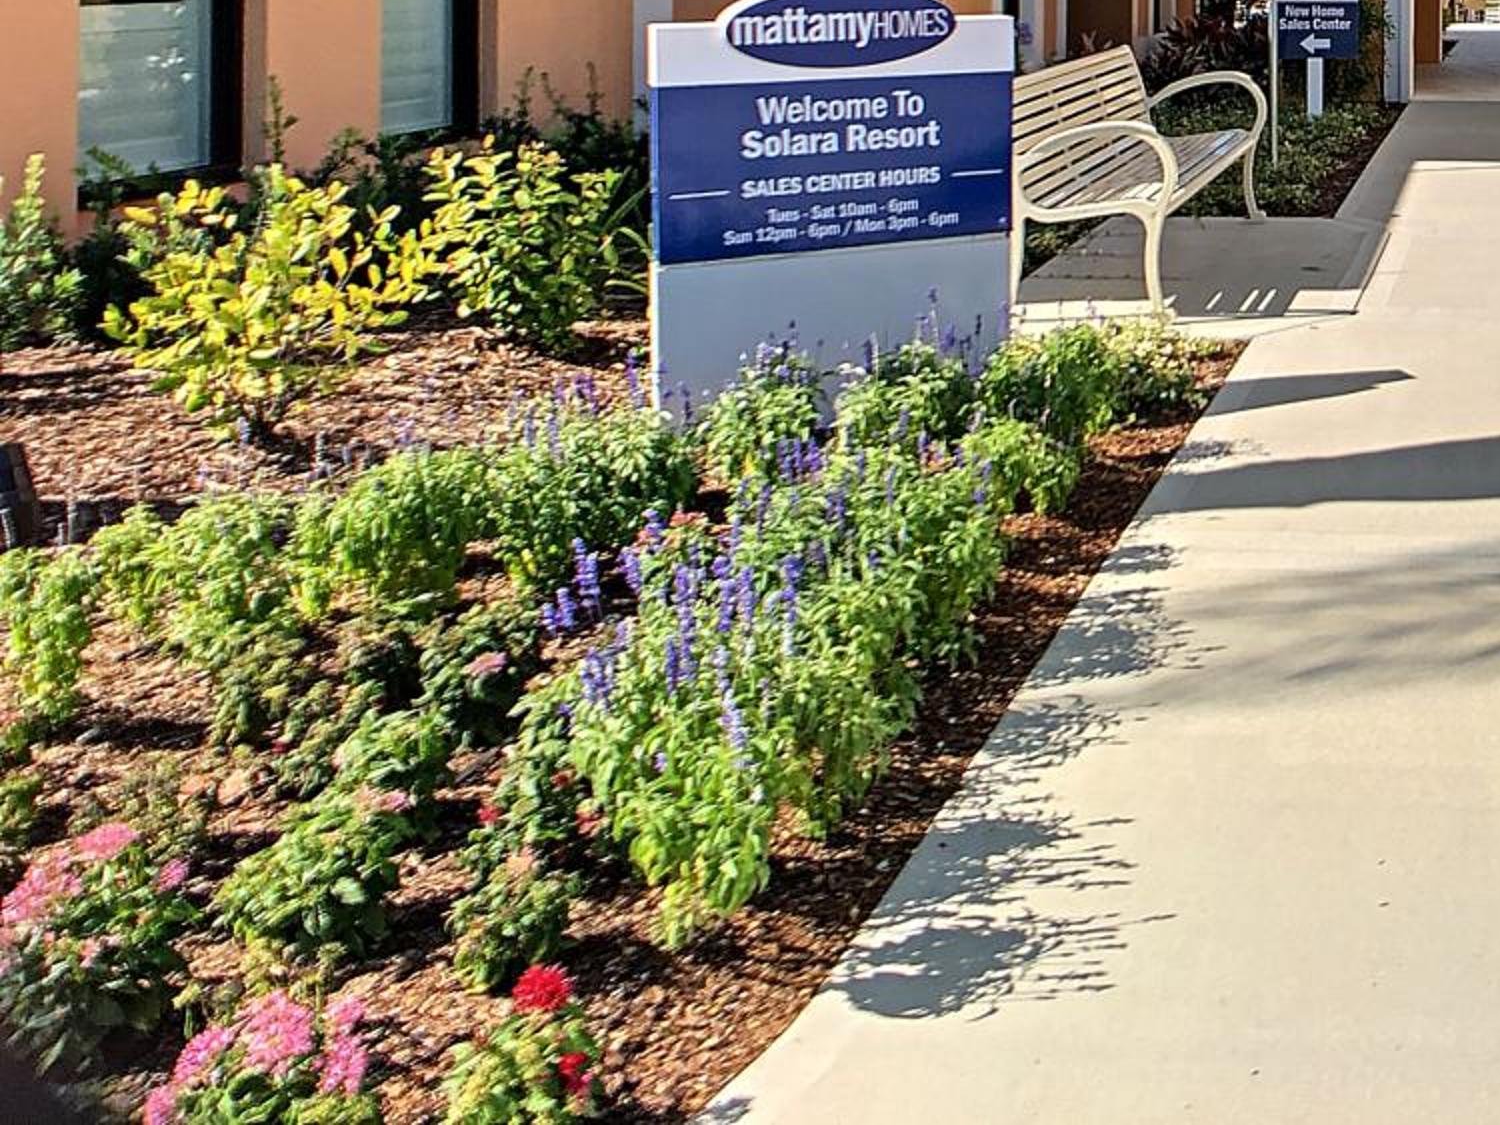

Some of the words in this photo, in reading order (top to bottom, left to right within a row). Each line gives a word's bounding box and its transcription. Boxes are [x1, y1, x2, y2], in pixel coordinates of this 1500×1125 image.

[732, 7, 949, 48] mattamyHOMES
[1279, 18, 1310, 30] Sales
[1313, 18, 1352, 30] Center
[1285, 5, 1310, 17] New
[1311, 5, 1345, 17] Home
[756, 95, 887, 125] Welcome
[892, 90, 924, 116] To
[740, 129, 840, 159] Solara
[846, 121, 941, 152] Resort
[741, 177, 802, 199] SALES
[805, 172, 876, 193] CENTER
[878, 167, 941, 187] HOURS
[767, 208, 800, 224] Tues
[810, 205, 835, 220] Sat
[839, 201, 877, 218] 10am
[888, 198, 919, 217] 6pm
[723, 229, 752, 246] Sun
[755, 226, 797, 245] 12pm
[808, 222, 840, 242] 6pm
[854, 217, 885, 233] Mon
[928, 211, 959, 230] 6pm
